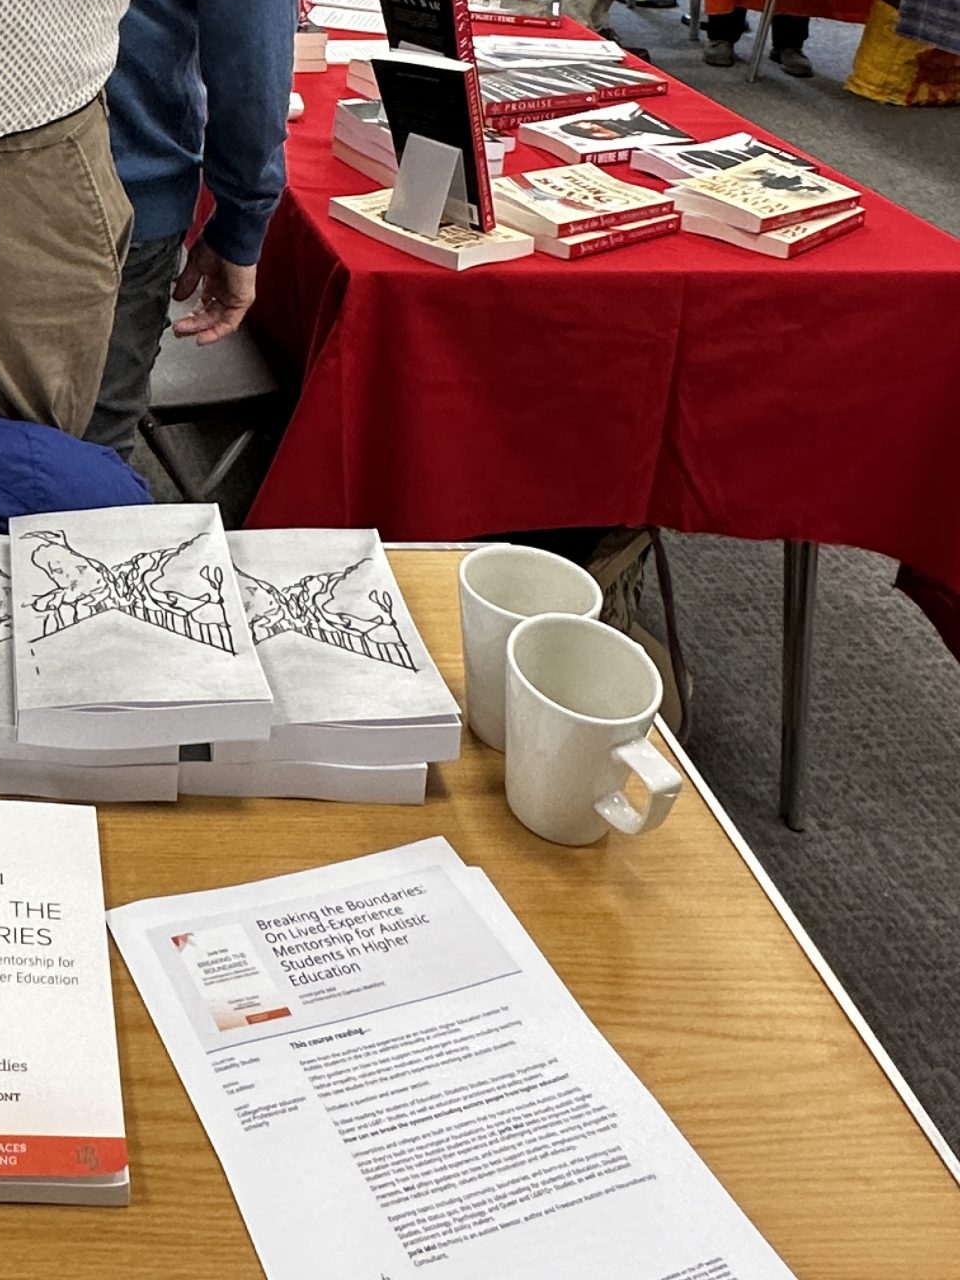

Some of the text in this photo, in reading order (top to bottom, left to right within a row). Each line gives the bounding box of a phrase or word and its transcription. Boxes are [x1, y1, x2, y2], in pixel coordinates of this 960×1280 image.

[505, 99, 552, 112] PROMISE
[9, 900, 62, 920] THE
[255, 884, 428, 933] Breaking the Boundaries:
[263, 904, 406, 944] On Lived-Experience
[271, 913, 430, 960] Mentorship for Autistic
[58, 956, 75, 968] for
[279, 932, 413, 972] Students in Higher
[16, 972, 79, 986] Education
[287, 960, 362, 987] Education
[288, 1039, 307, 1049] This
[306, 1034, 334, 1045] course
